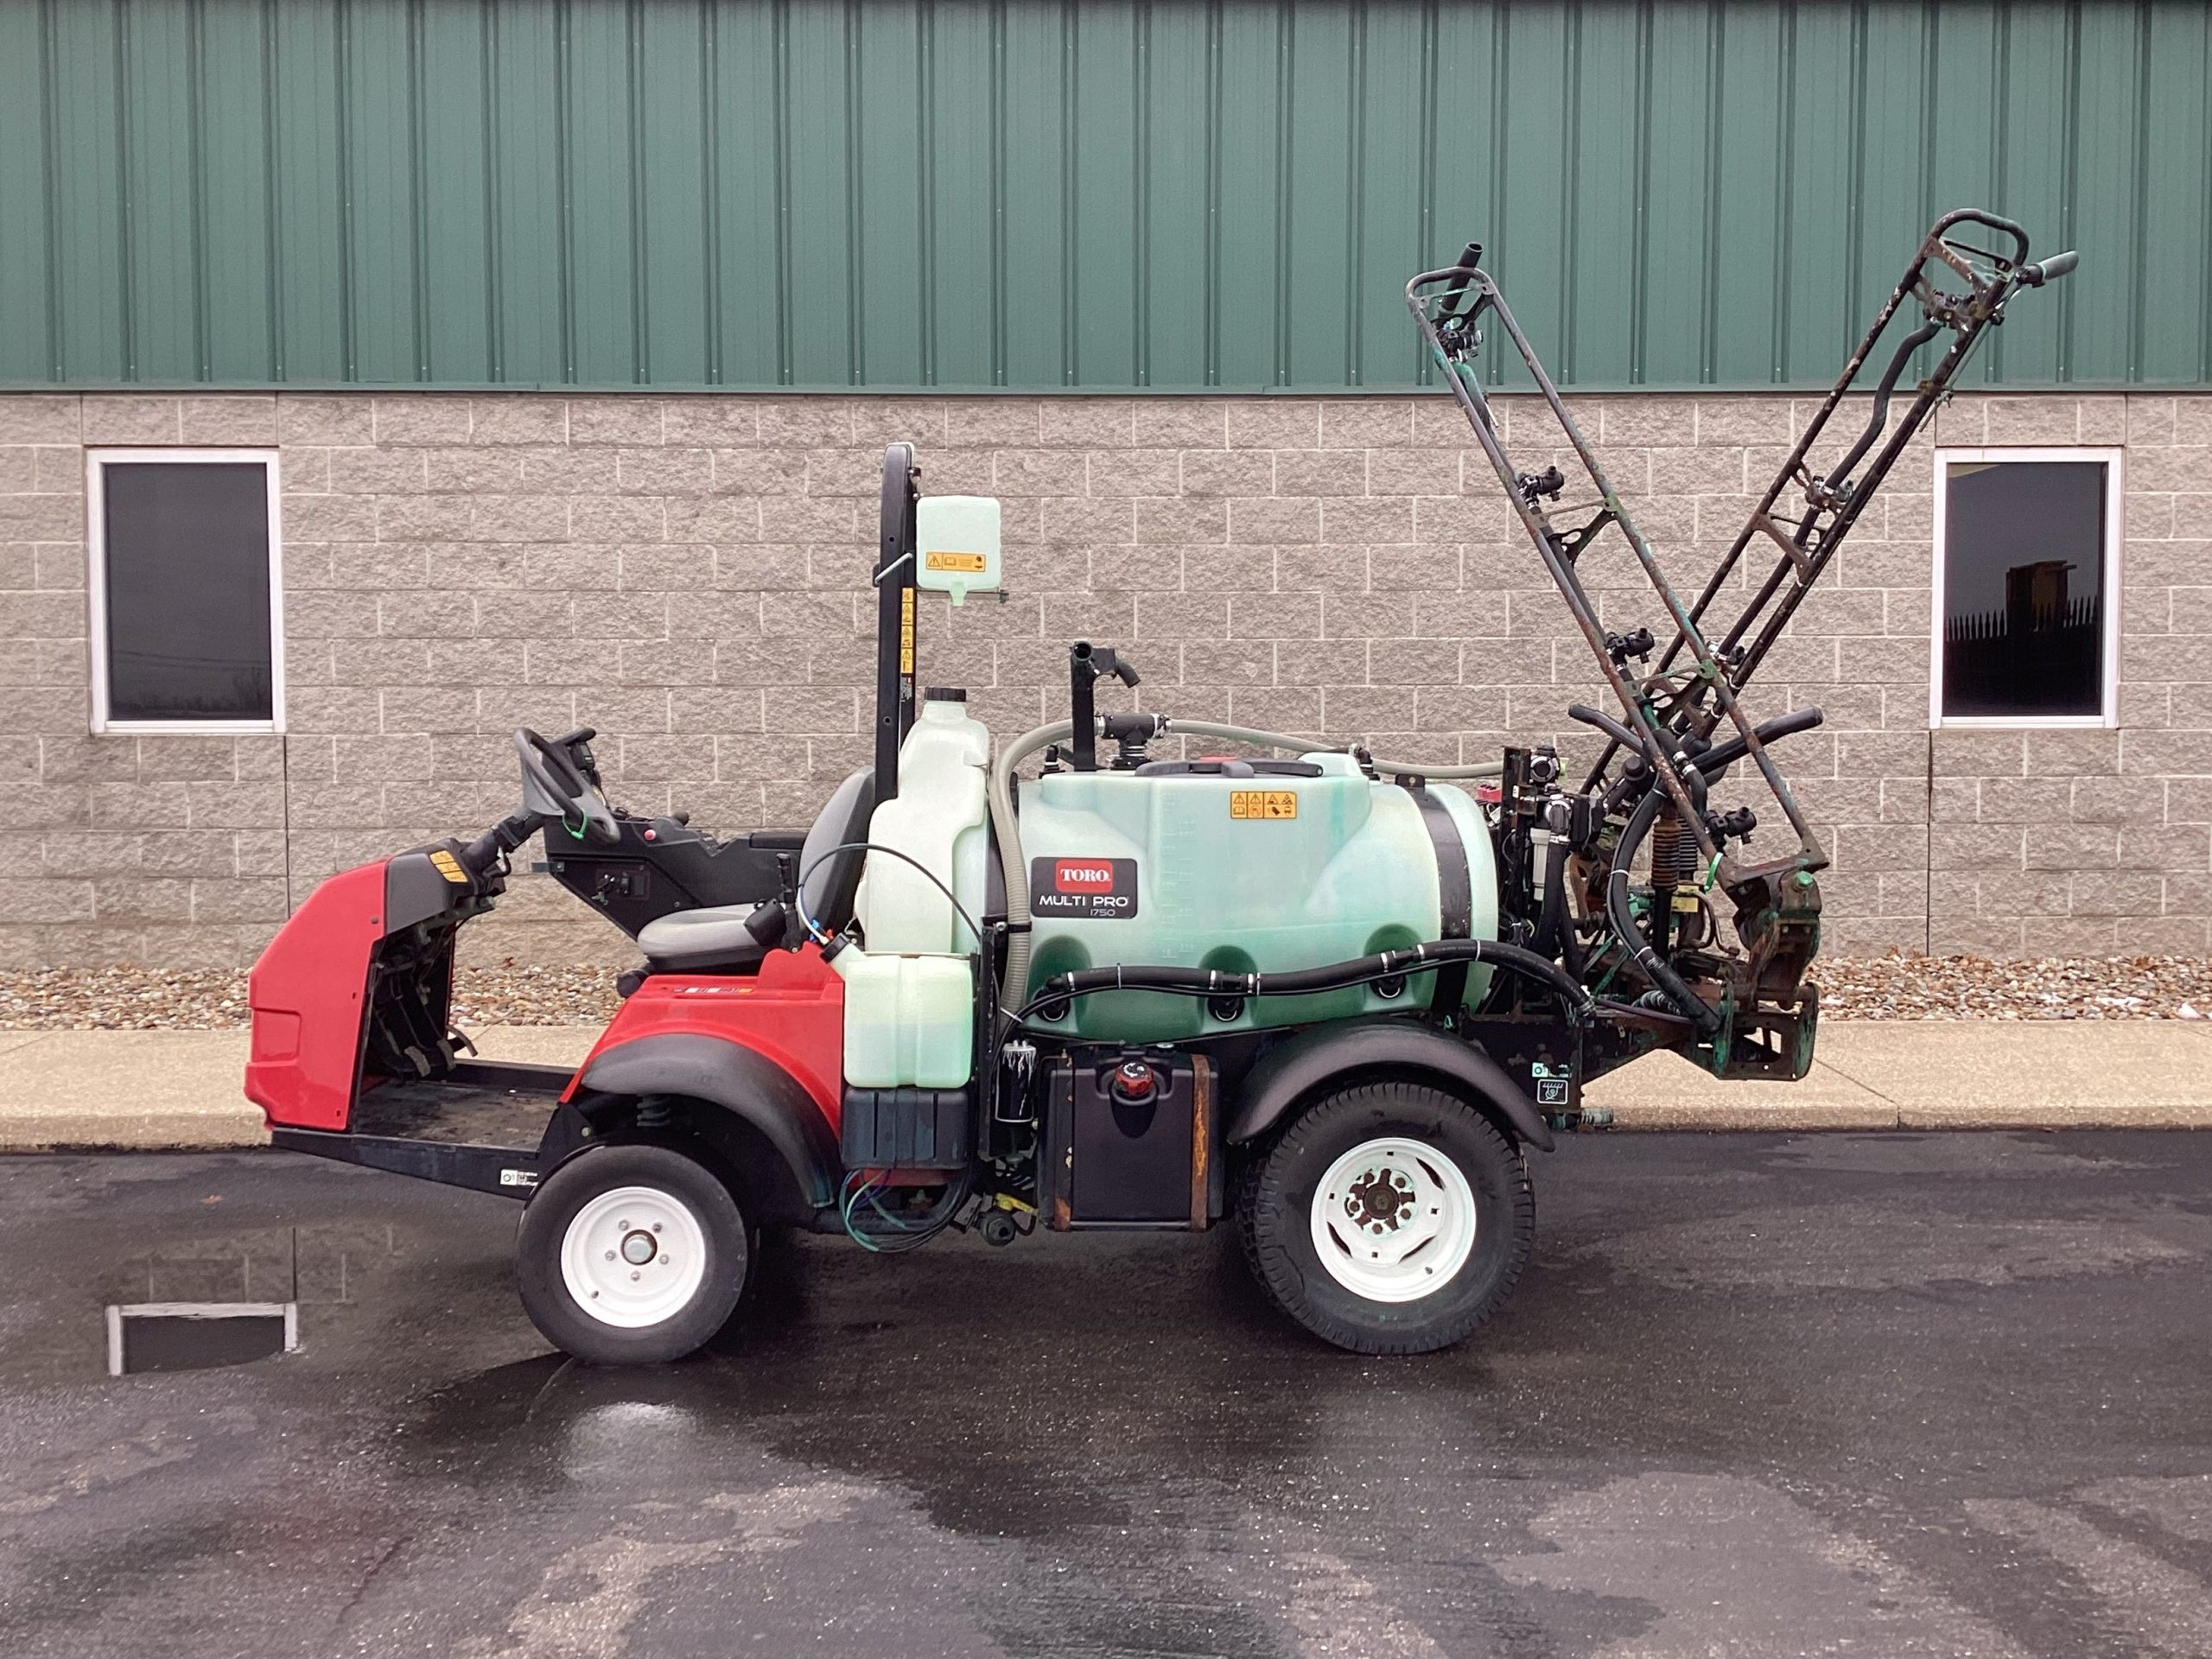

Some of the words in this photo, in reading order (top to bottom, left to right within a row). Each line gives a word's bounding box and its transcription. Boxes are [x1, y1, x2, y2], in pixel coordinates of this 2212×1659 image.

[1060, 868, 1109, 882] TORO
[1039, 895, 1086, 906] MULTI
[1092, 896, 1128, 907] PRO
[1090, 908, 1116, 917] 1750
